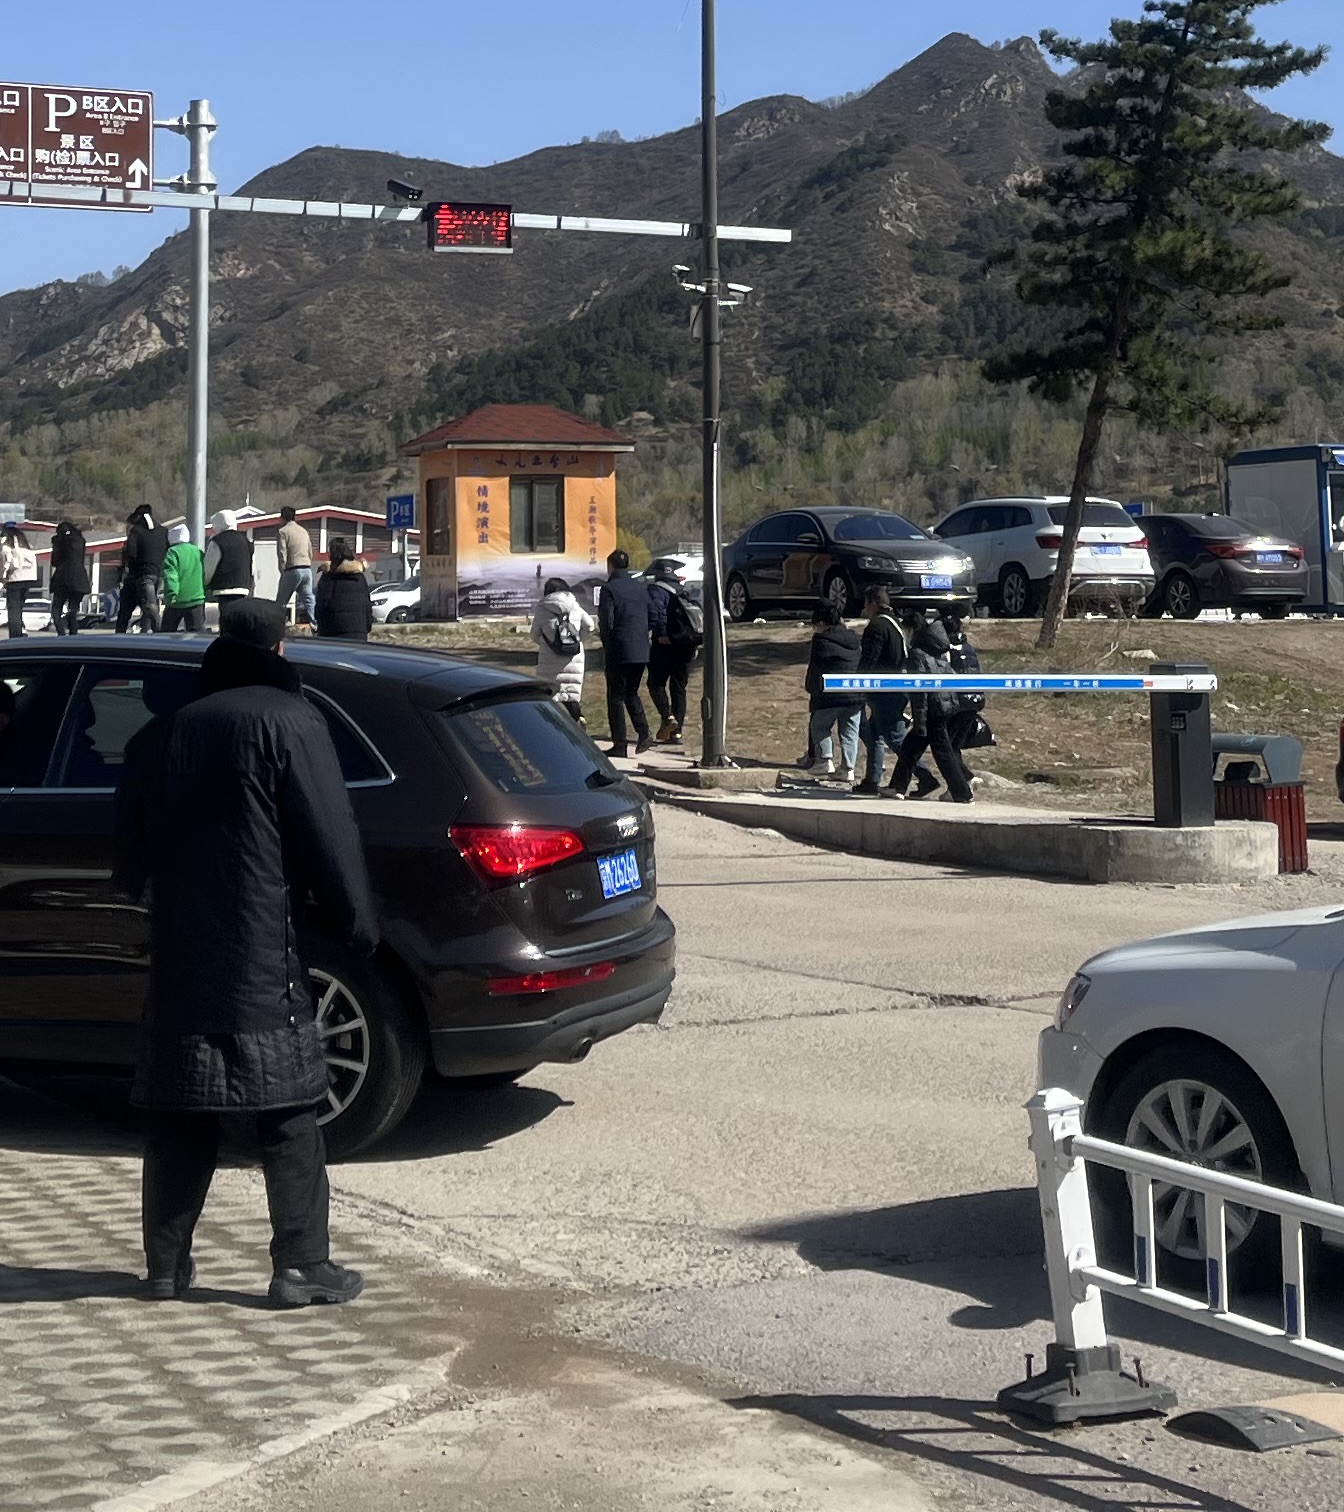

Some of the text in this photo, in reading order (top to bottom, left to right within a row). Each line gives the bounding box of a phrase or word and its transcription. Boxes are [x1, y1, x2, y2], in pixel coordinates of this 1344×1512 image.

[44, 93, 77, 132] P
[82, 95, 143, 114] B区入口
[60, 134, 94, 149] 景区
[35, 149, 119, 166] 购(检)票入口
